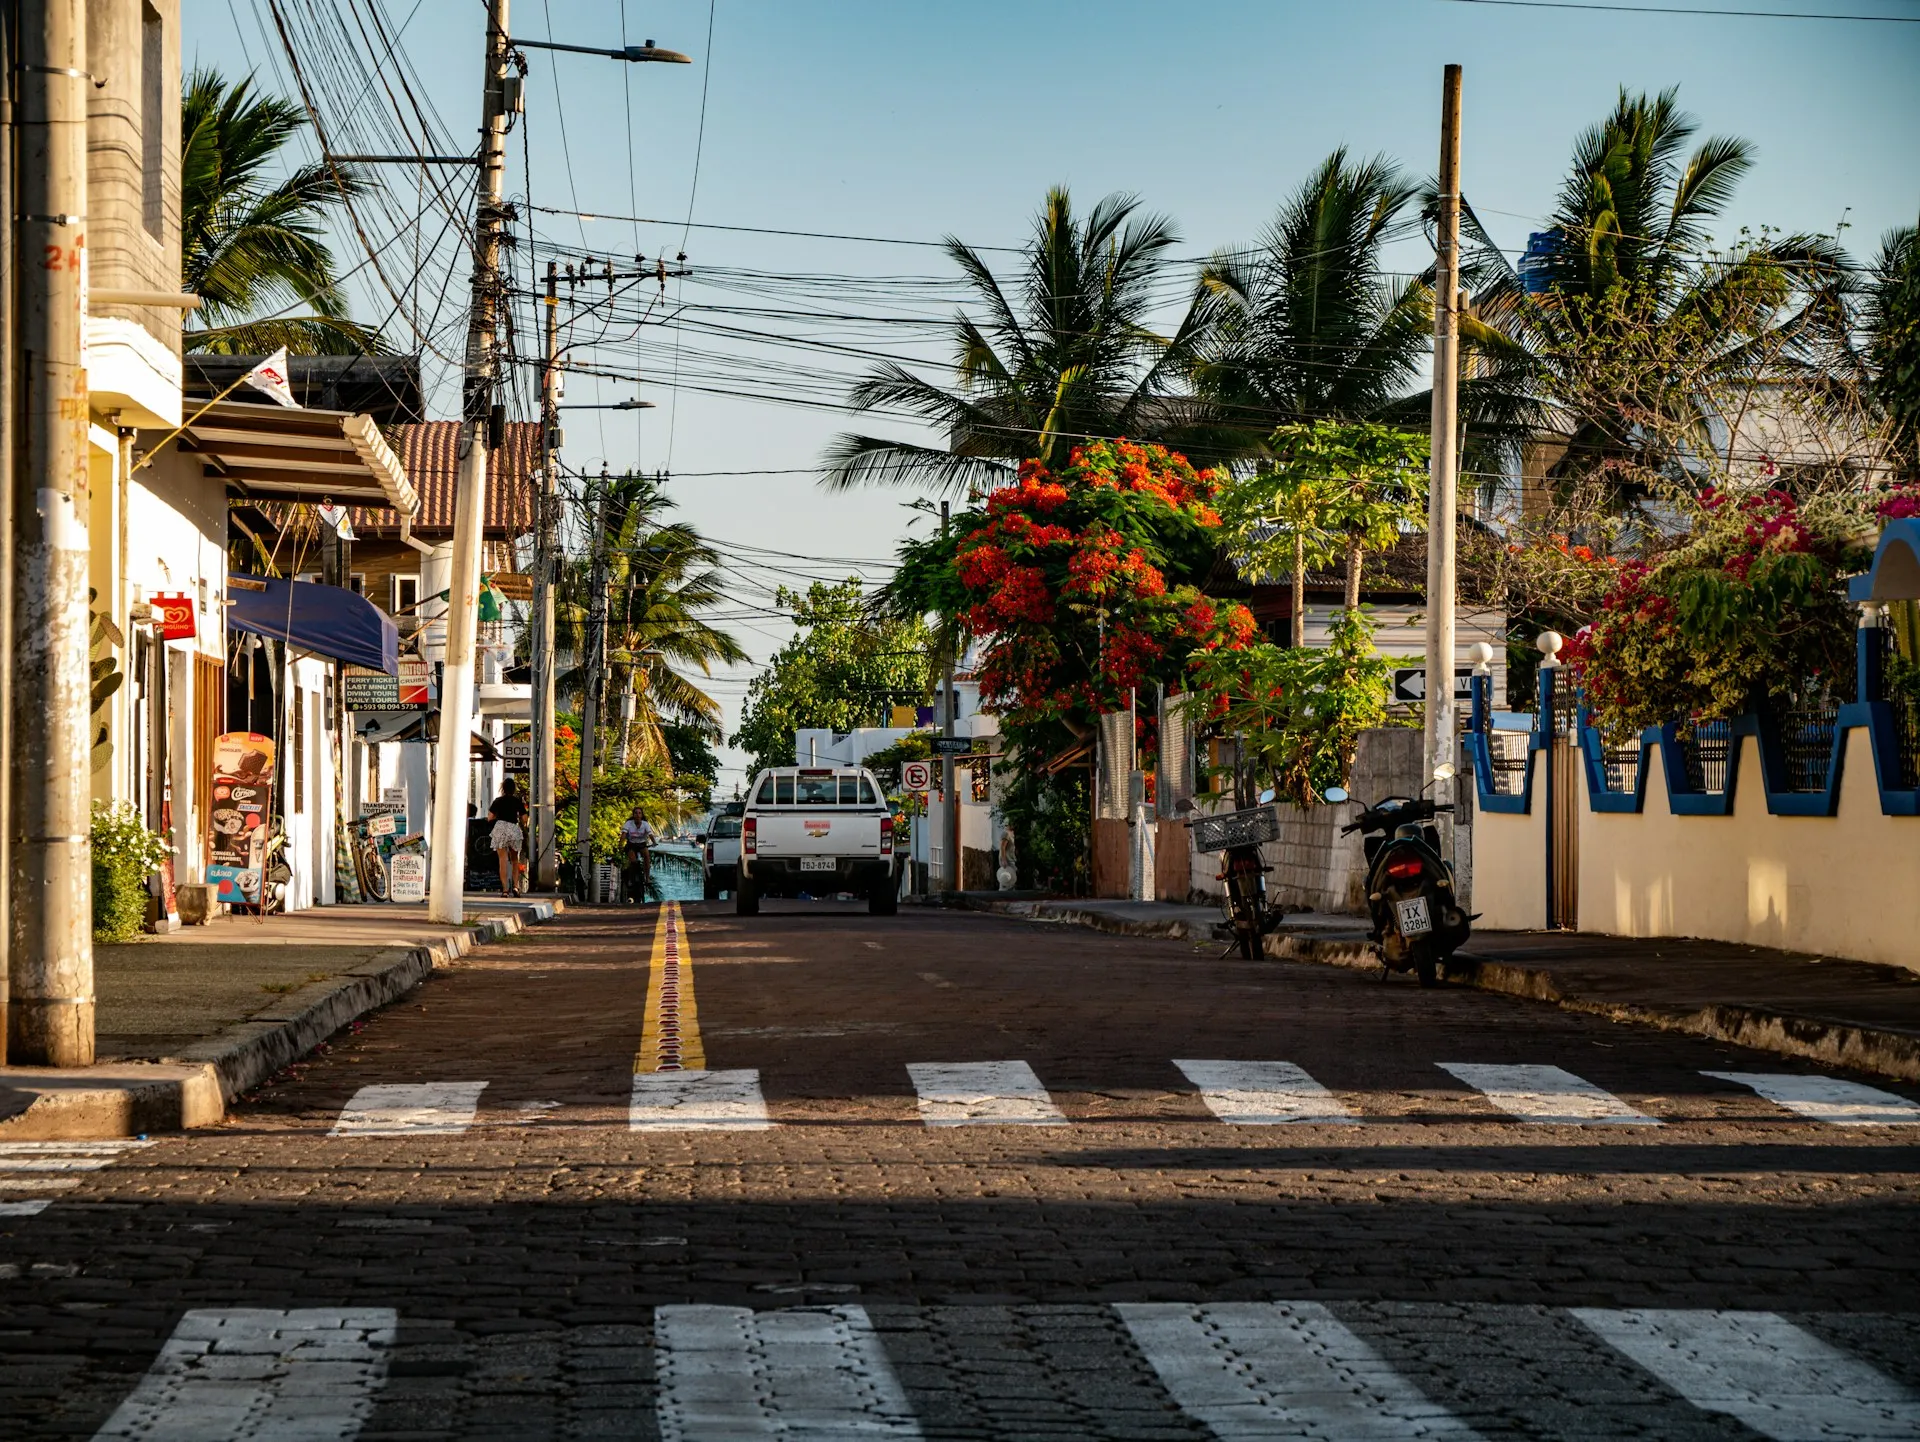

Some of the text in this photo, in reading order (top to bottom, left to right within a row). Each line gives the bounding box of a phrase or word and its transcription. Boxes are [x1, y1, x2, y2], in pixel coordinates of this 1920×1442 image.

[911, 769, 922, 783] E
[802, 861, 835, 869] TBJ-8748
[1405, 906, 1421, 919] IX
[1404, 917, 1428, 931] 328H
